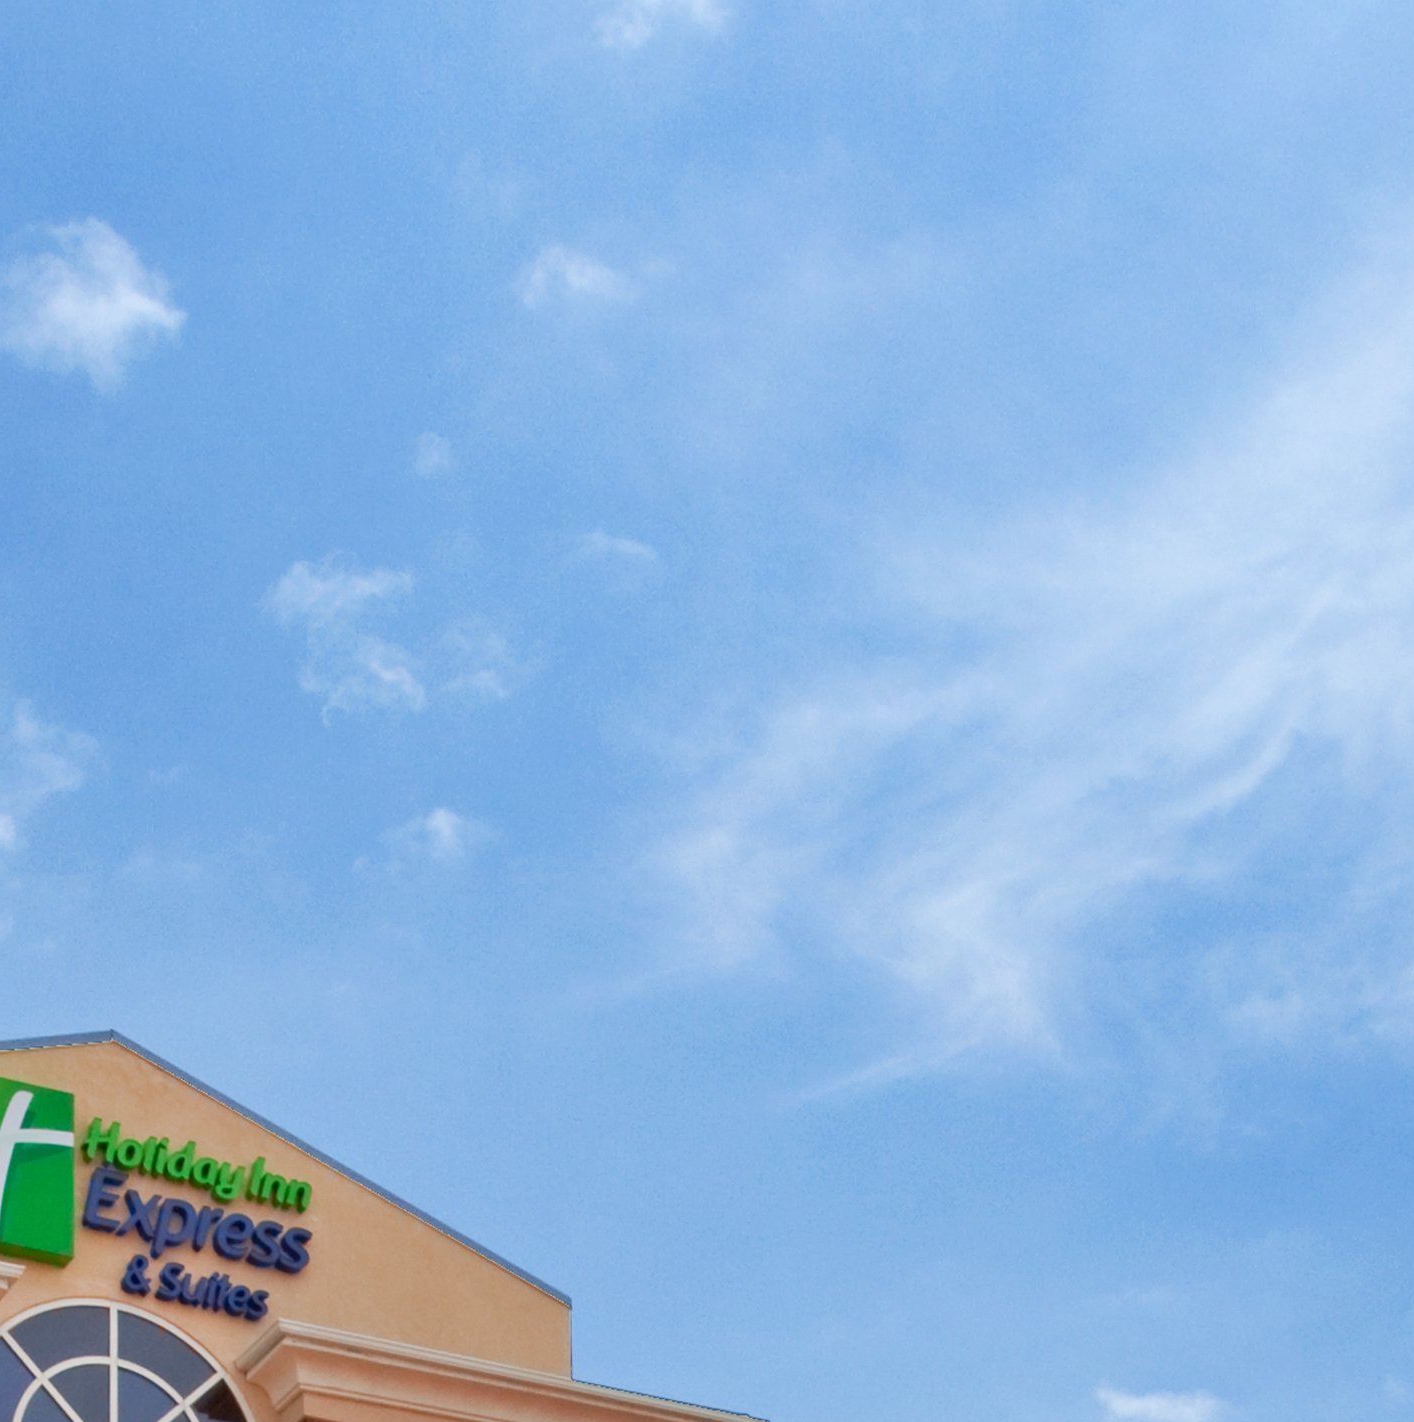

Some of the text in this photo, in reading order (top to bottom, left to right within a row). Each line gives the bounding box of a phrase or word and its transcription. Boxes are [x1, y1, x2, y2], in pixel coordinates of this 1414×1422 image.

[82, 1116, 313, 1214] Holiday Inn
[82, 1166, 313, 1275] Express
[121, 1253, 270, 1323] & Suites
